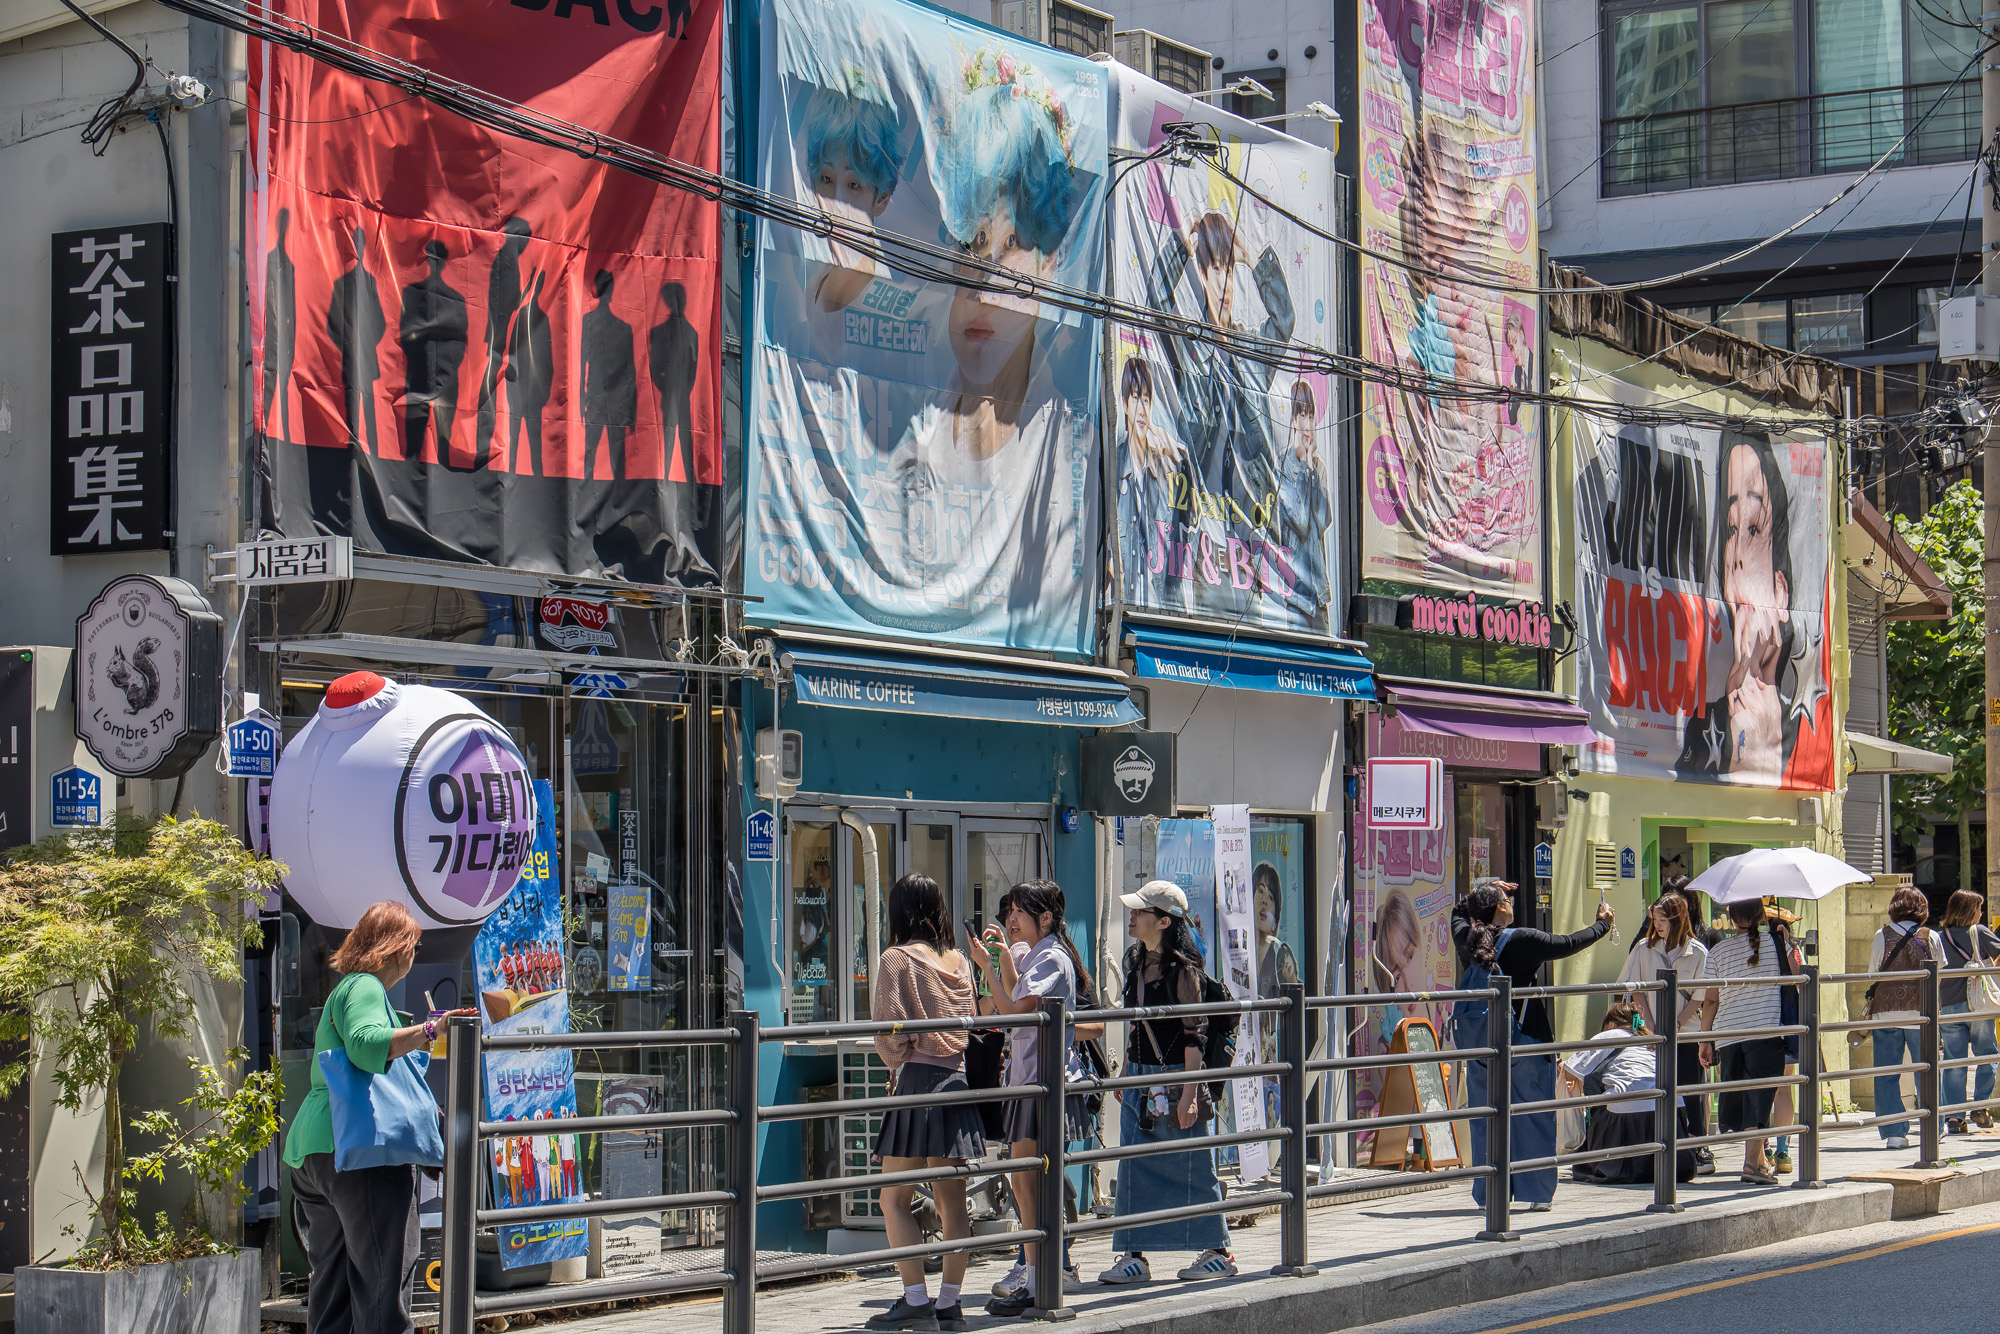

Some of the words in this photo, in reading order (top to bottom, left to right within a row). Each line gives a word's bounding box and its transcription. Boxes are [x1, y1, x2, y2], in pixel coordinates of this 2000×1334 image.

[1076, 70, 1098, 85] 1995
[1506, 199, 1526, 235] 06
[863, 280, 917, 318] 김태형
[845, 312, 874, 345] 많이
[878, 319, 926, 352] 보라해
[1071, 397, 1088, 512] WELCOME
[1167, 472, 1188, 511] 12
[1191, 487, 1244, 525] years
[1250, 492, 1276, 529] of
[1147, 520, 1194, 581] Jin
[1200, 531, 1222, 586] &
[1225, 537, 1296, 598] BTS
[759, 541, 836, 591] GOOD
[842, 556, 897, 602] BYE!
[1641, 566, 1664, 600] IS
[87, 612, 120, 643] PATISSERIE
[148, 611, 181, 641] BOULANGERIE
[882, 616, 902, 627] FROM
[902, 618, 929, 631] CHINESE
[930, 621, 945, 632] FANS
[1412, 592, 1478, 638] merci
[1482, 600, 1551, 648] cookie
[1154, 658, 1177, 674] Bom
[1178, 661, 1211, 681] market
[808, 675, 862, 700] MARINE
[866, 681, 915, 705] COFFEE
[1277, 669, 1360, 695] 050-7017-73461
[1037, 697, 1072, 717] 가맹문의
[1073, 700, 1119, 718] 1599-9341
[93, 706, 148, 740] L'ombre
[150, 708, 174, 735] 378
[232, 729, 270, 751] 11-50
[1399, 728, 1449, 758] merci
[1453, 737, 1507, 762] cookie
[57, 778, 97, 799] 11-54
[428, 770, 536, 825] 아미가
[1373, 807, 1425, 818] 메르시쿠키
[750, 820, 773, 838] 11-48
[1235, 839, 1244, 852] BTS
[1256, 834, 1292, 852] ARMY
[1536, 850, 1551, 861] 11-44
[1622, 852, 1635, 864] 11-42
[609, 892, 646, 908] WELCOME
[609, 908, 633, 926] HOME
[610, 926, 628, 943] BTS
[653, 941, 676, 952] open
[496, 1063, 567, 1096] 방탄소년단
